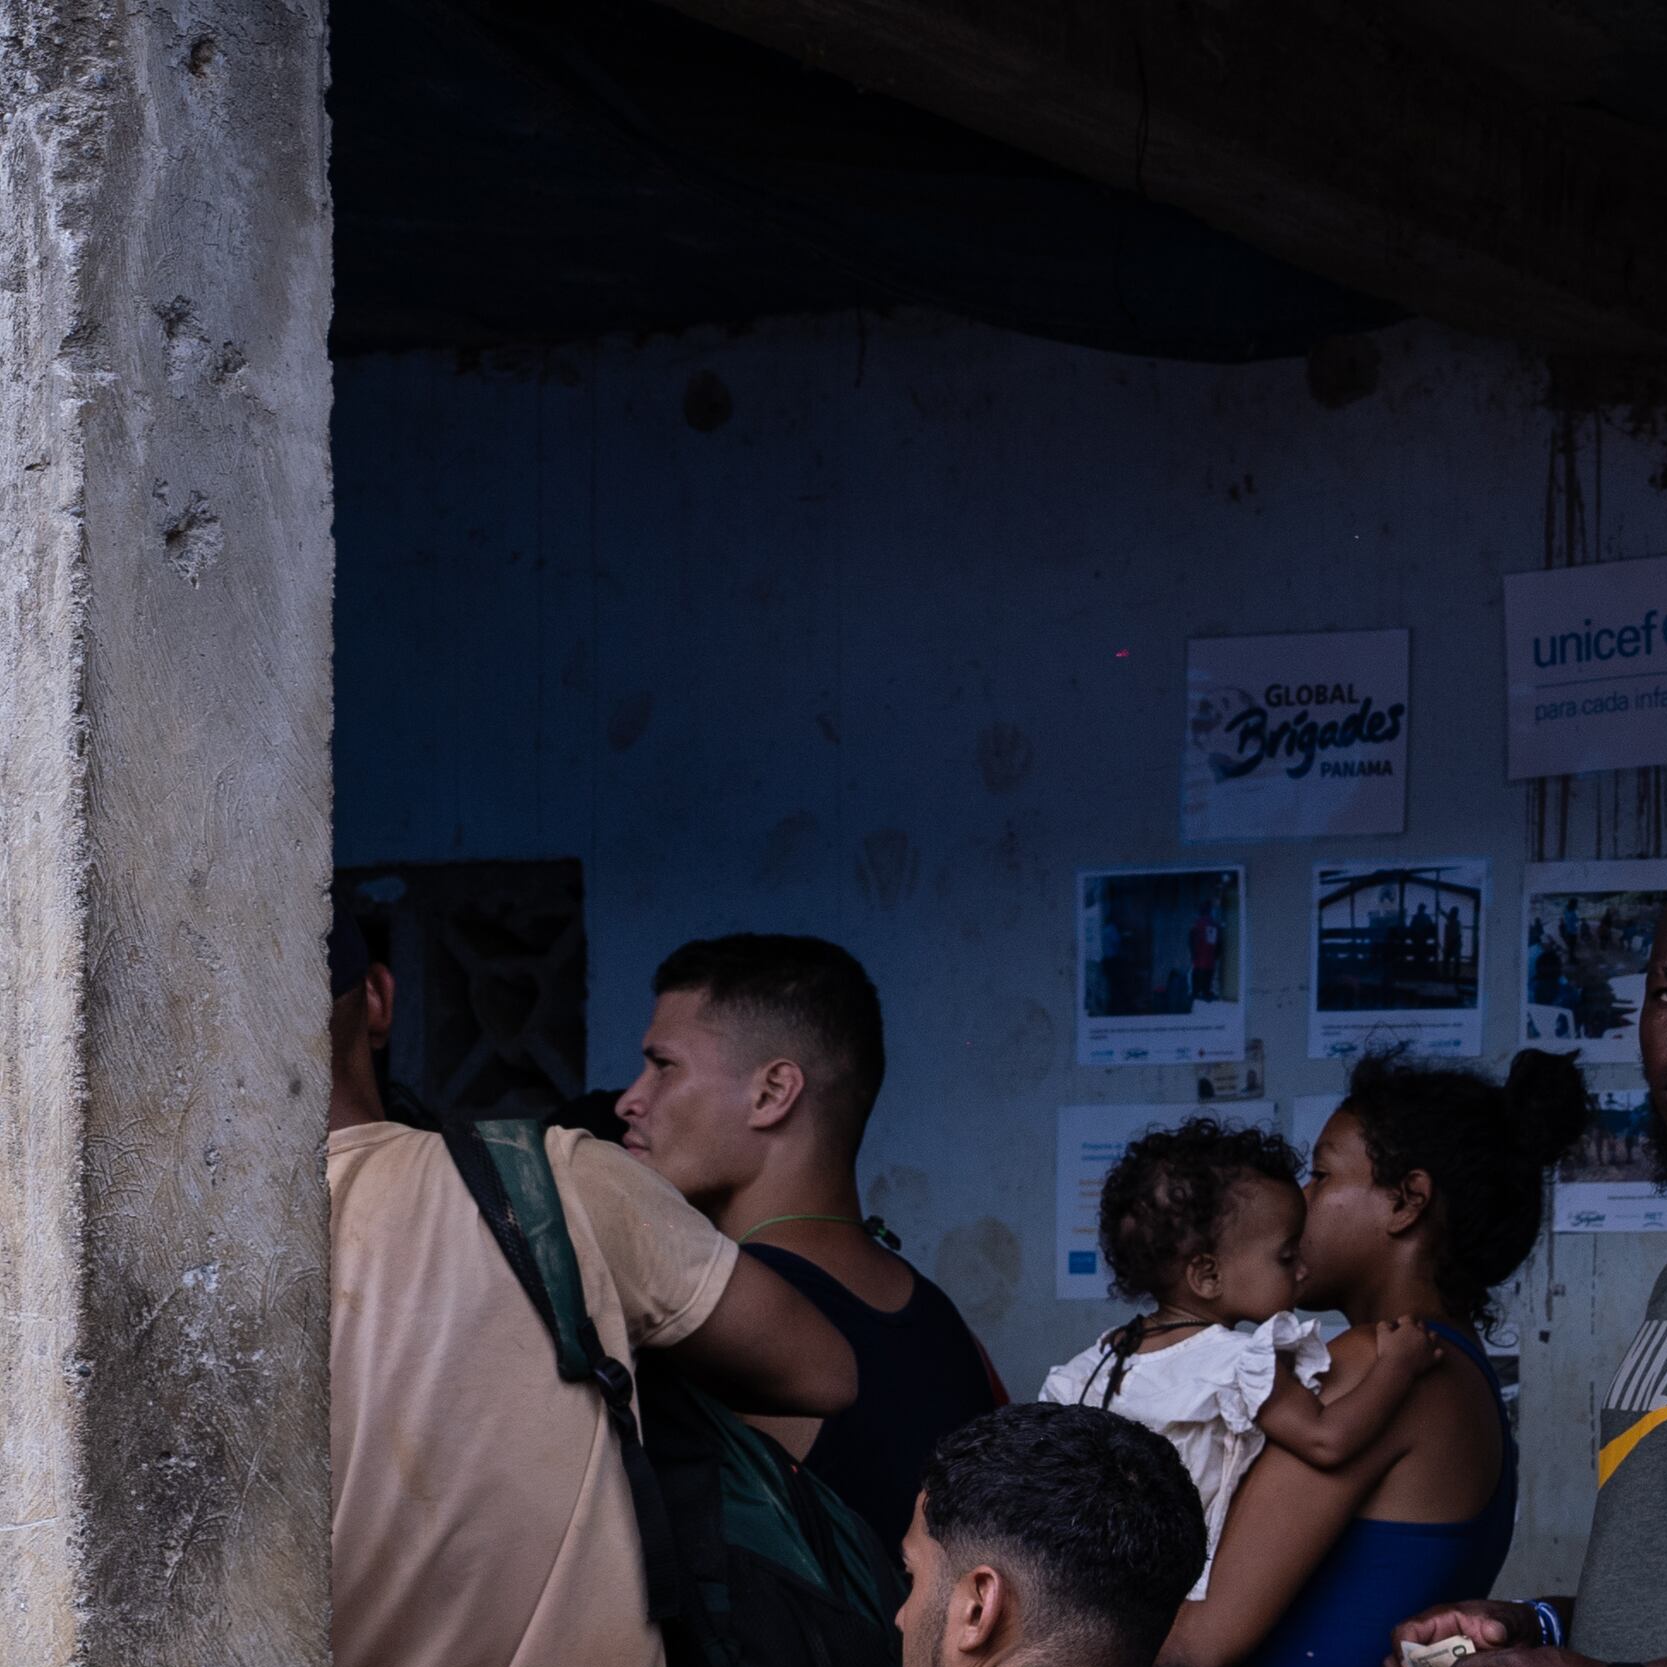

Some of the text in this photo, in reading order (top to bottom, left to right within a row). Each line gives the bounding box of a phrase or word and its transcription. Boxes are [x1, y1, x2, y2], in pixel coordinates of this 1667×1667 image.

[1534, 609, 1657, 668] unicef
[1264, 683, 1360, 707] GLOBAL
[1534, 698, 1577, 724] para
[1581, 690, 1629, 715] cada
[1218, 697, 1405, 780] Brigades
[1320, 759, 1393, 778] PANAMA
